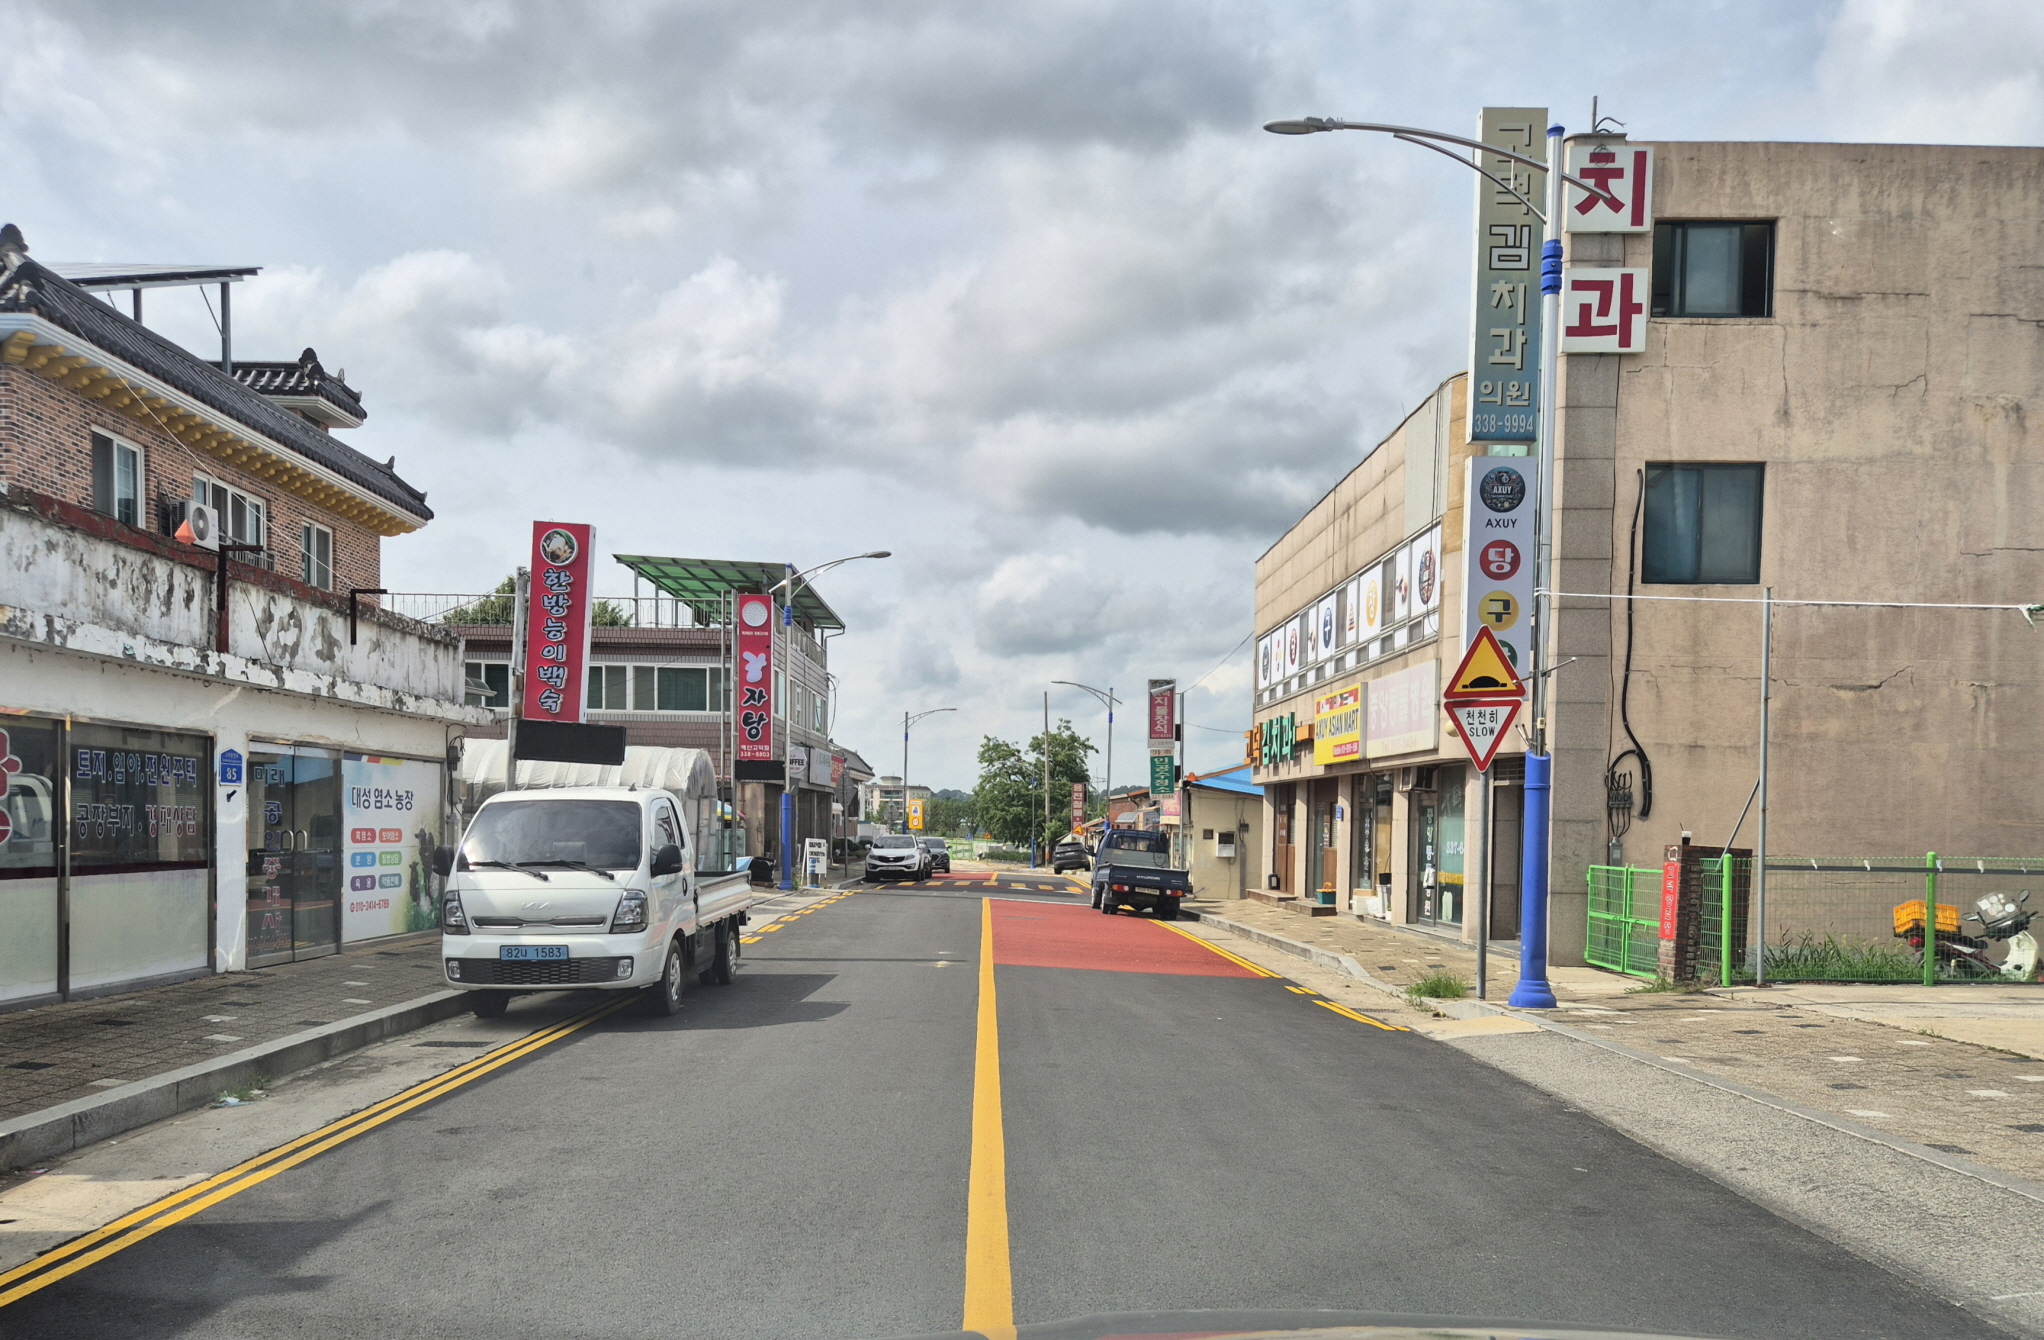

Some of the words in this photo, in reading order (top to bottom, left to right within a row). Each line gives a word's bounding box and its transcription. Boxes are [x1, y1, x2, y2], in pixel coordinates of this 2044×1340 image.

[1565, 150, 1648, 348] 치과
[1479, 381, 1530, 406] 의원
[1475, 414, 1533, 433] 338-9994
[1493, 485, 1512, 494] AXUY
[1485, 518, 1517, 528] AXUY
[537, 568, 573, 713] 한방능이백숙
[1328, 711, 1343, 738] ASIAN
[1344, 707, 1359, 734] MART
[1466, 709, 1498, 726] 천천히
[1469, 727, 1496, 737] SLOW
[226, 767, 238, 781] 85
[254, 766, 285, 788] 미래
[351, 786, 371, 810] 대성
[374, 787, 393, 810] 염소
[395, 789, 414, 811] 농장
[1446, 841, 1464, 855] 337-8
[262, 801, 283, 933] 공인중개사
[1425, 808, 1434, 916] 중앙동원
[534, 947, 562, 959] 1583
